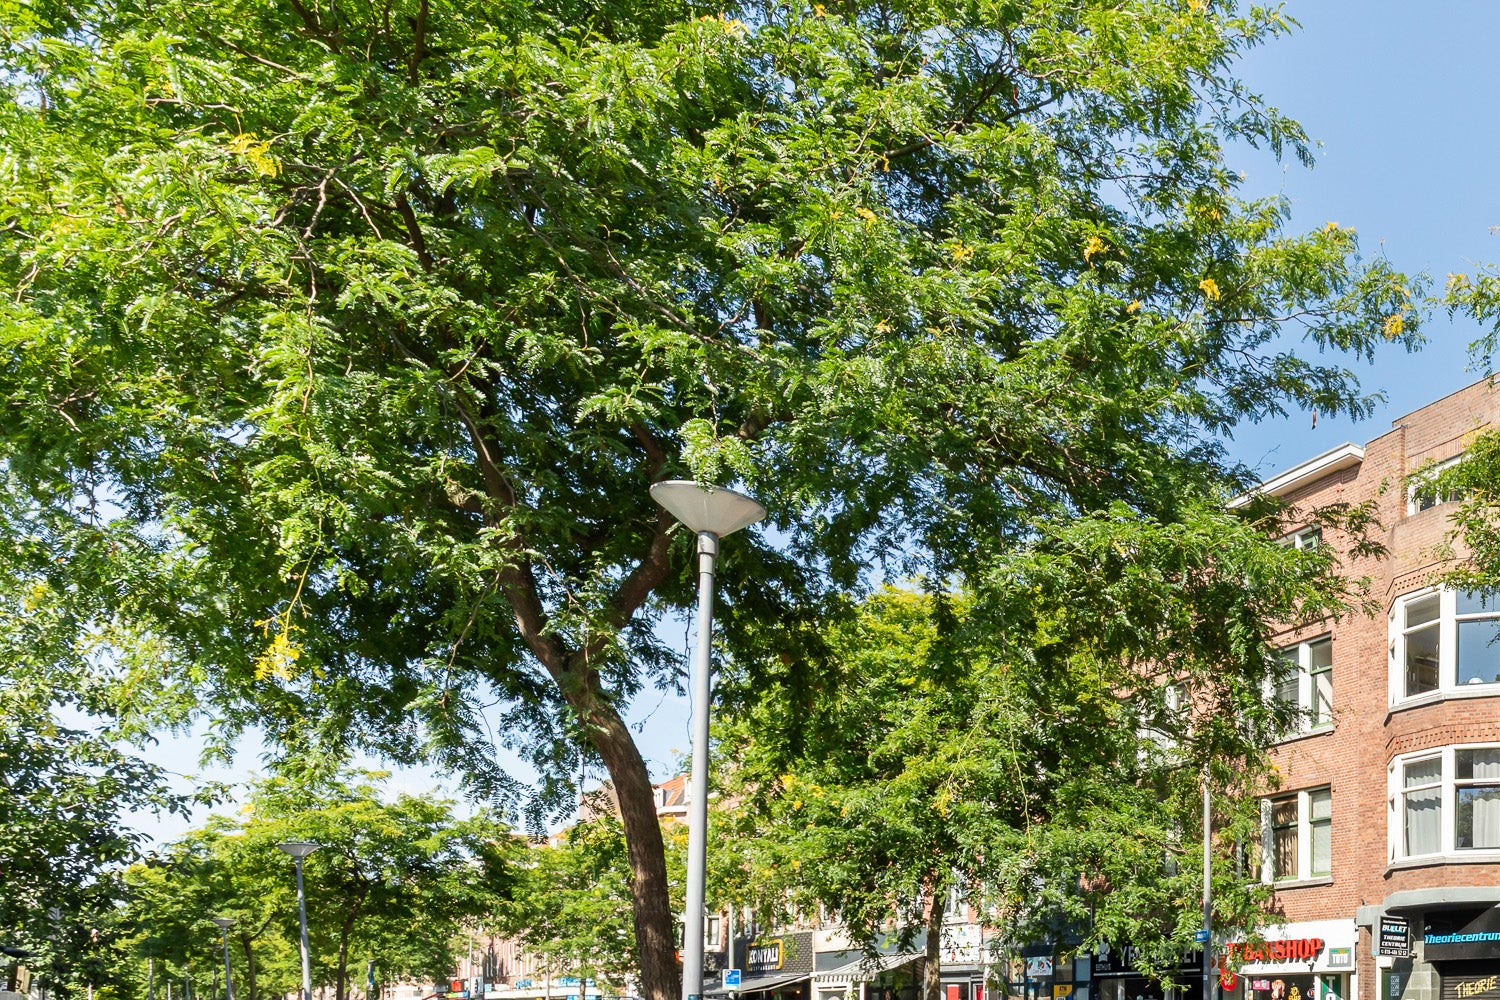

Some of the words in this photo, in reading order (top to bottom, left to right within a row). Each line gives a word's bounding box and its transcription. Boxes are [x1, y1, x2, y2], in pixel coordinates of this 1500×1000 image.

[1382, 924, 1407, 933] BULLET
[1383, 934, 1406, 942] THEORIE
[1332, 954, 1348, 964] TOTO
[1454, 976, 1497, 998] THEORIE
